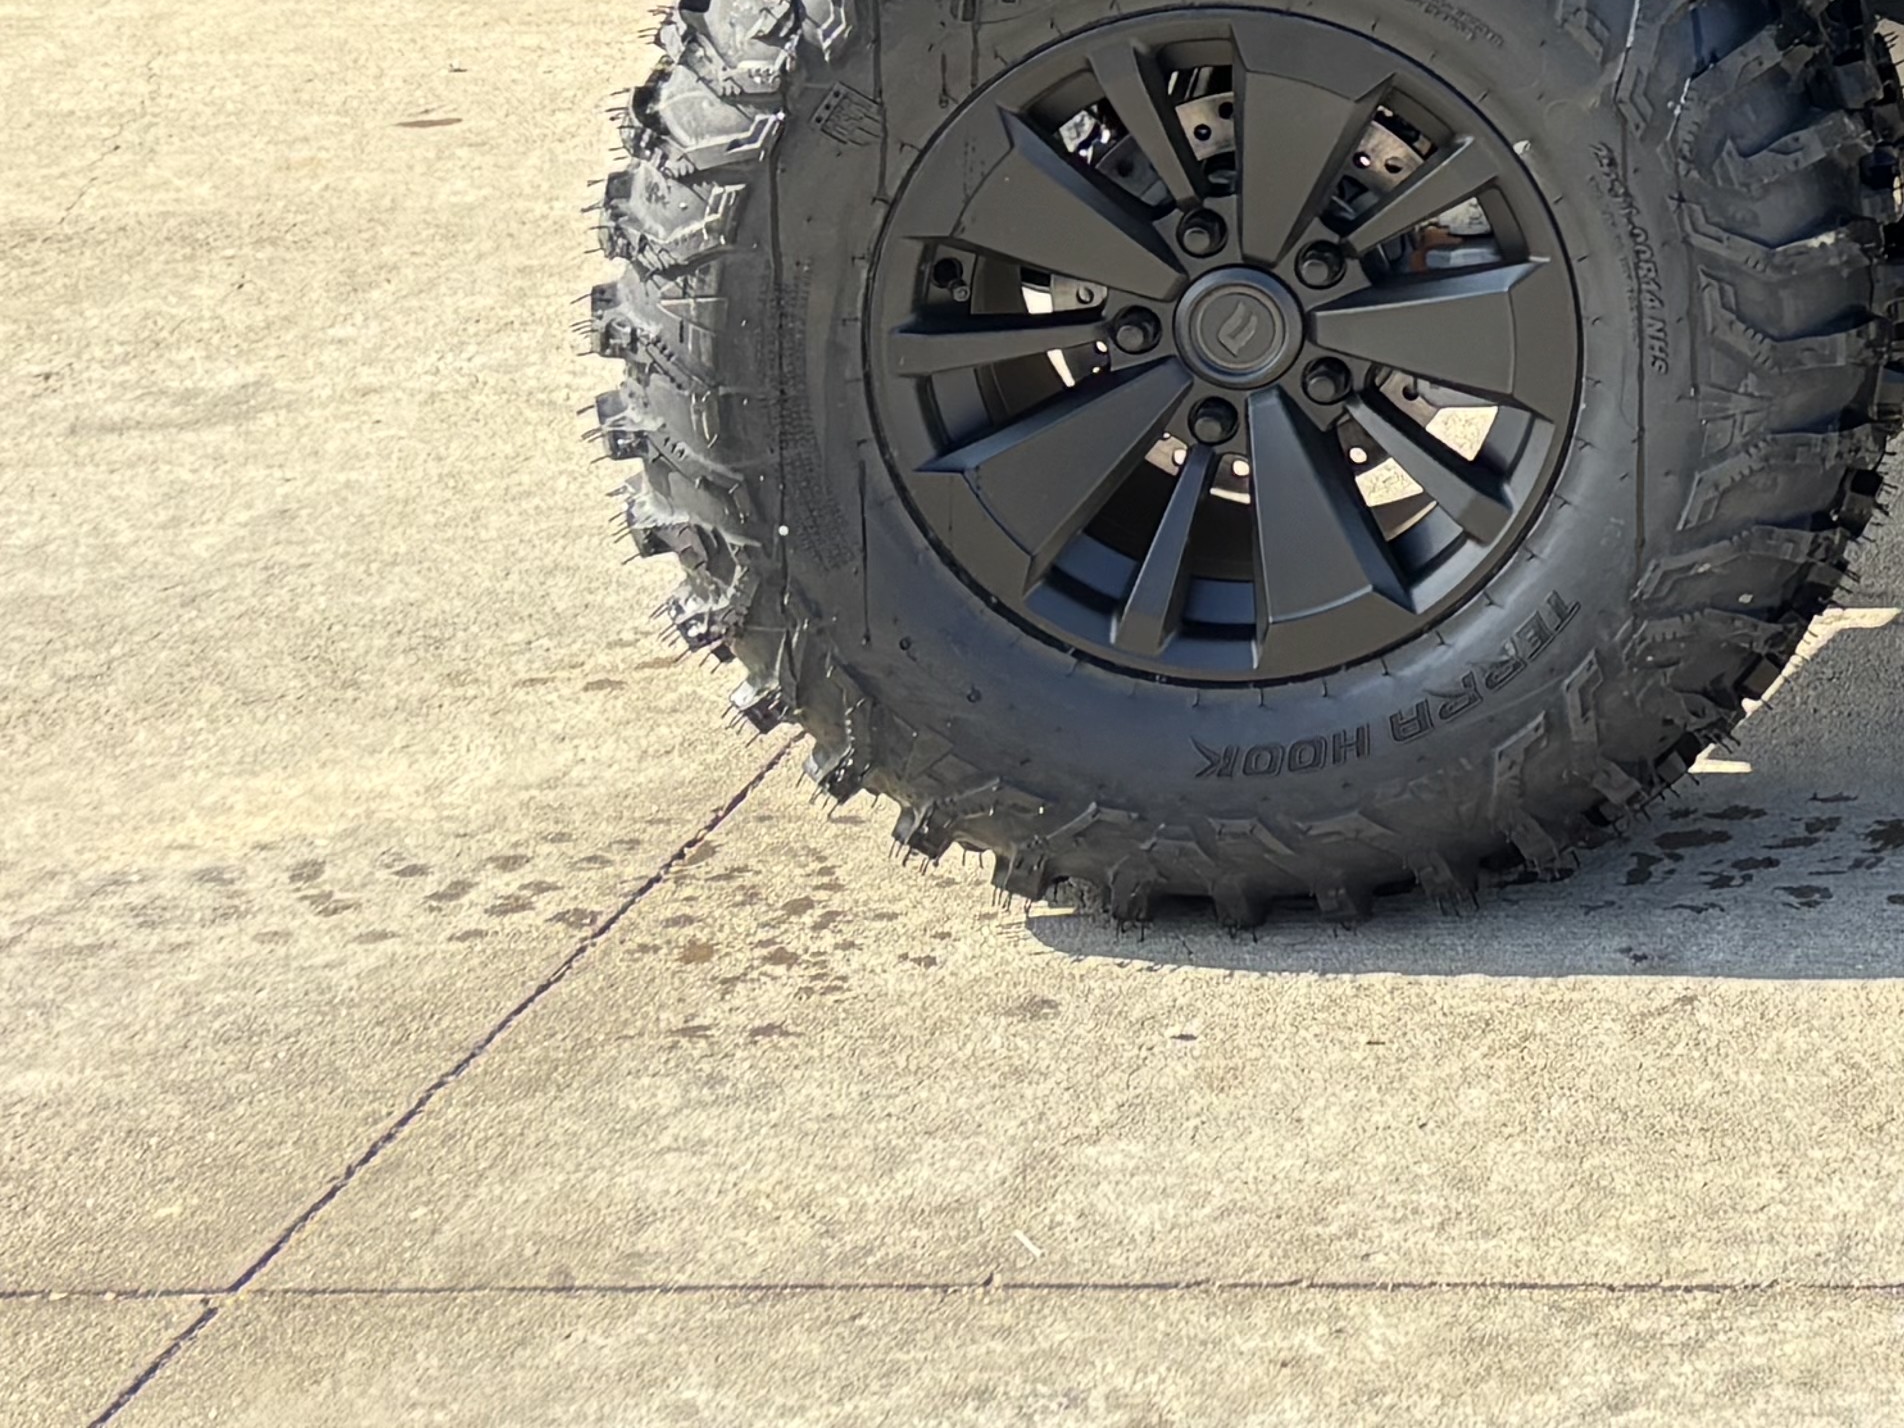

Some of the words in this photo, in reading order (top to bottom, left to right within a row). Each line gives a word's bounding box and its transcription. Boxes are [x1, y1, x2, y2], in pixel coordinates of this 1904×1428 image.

[1648, 317, 1670, 376] NHS
[1388, 589, 1581, 743] TERRA
[1190, 722, 1371, 778] HOOK
